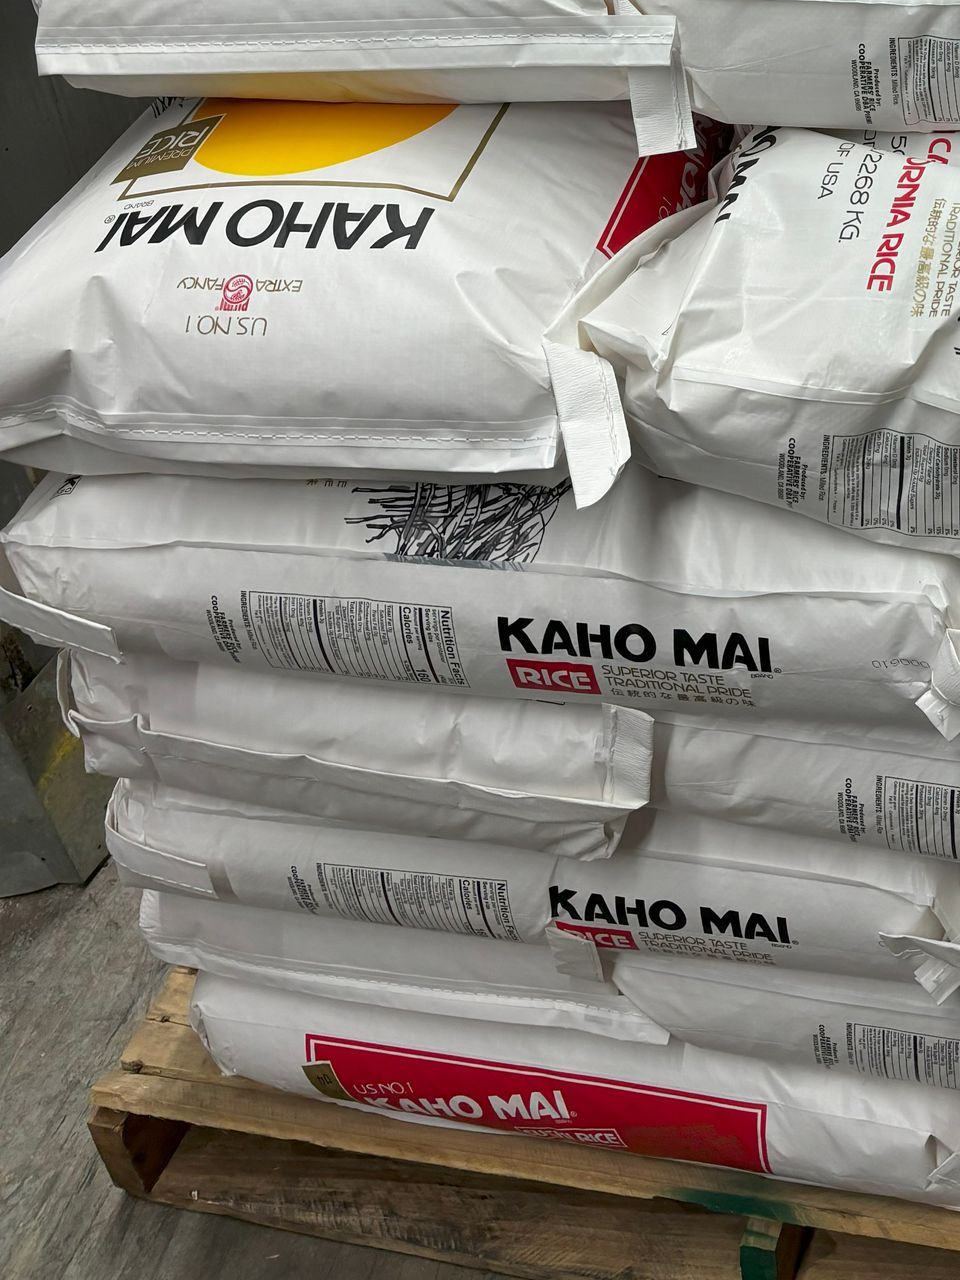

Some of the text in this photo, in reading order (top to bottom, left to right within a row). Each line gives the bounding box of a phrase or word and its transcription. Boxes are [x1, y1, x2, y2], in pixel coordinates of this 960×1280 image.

[128, 147, 193, 169] PREMIUM
[134, 125, 209, 158] RICE
[817, 142, 855, 200] OF USA
[94, 199, 436, 253] KAHO MAI
[838, 209, 864, 243] KG.
[866, 232, 905, 292] RICE
[177, 277, 303, 292] EXTRA FANCY
[928, 279, 947, 318] PRIDE
[941, 281, 959, 317] TASTE
[785, 438, 796, 487] COOPERATIVE
[801, 464, 809, 488] Produced
[403, 606, 432, 682] Calories 160
[439, 610, 466, 686] Nutrition Facts
[497, 615, 771, 673] KAHO MAI
[516, 664, 725, 690] RICE SUPERIOR TASTE
[603, 677, 751, 699] TRADITIONAL PRIDE
[462, 879, 472, 911] Calories
[497, 882, 511, 924] Nutrition
[548, 885, 790, 944] KAHO MAI
[638, 931, 748, 951] SUPERIOR TASTE
[642, 939, 731, 957] TRADITIONAL
[733, 950, 773, 961] PRIDE
[363, 1090, 572, 1121] KAHO MAI
[577, 1130, 618, 1146] RICE
